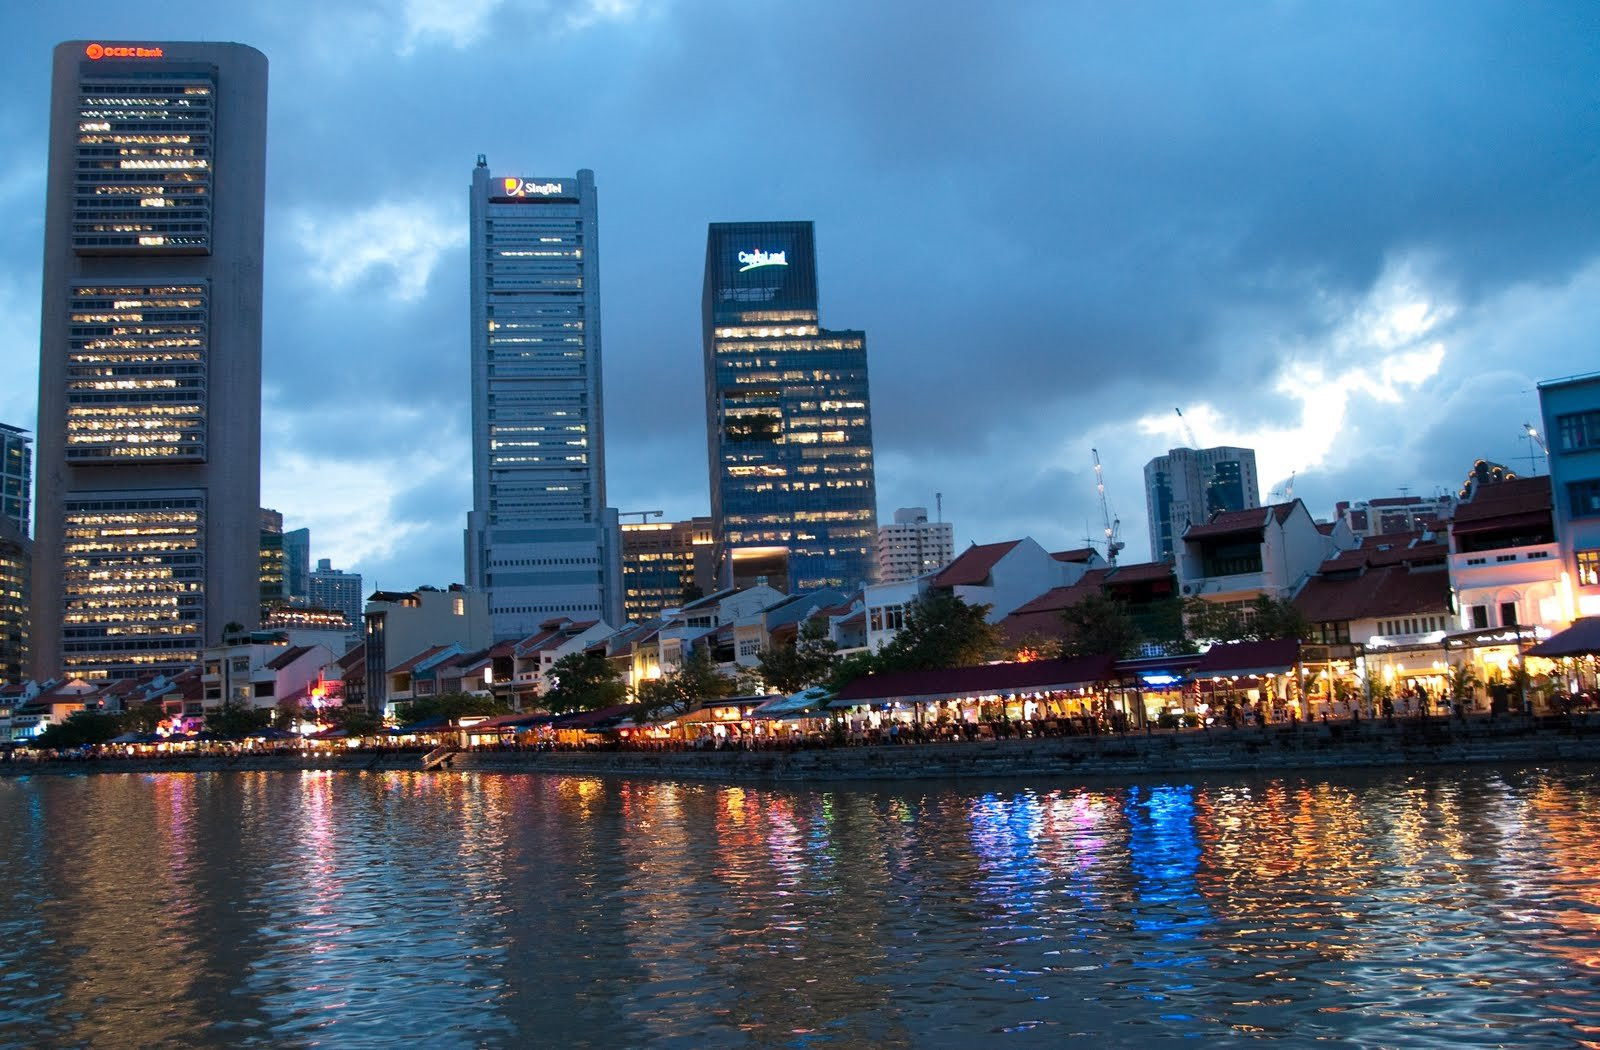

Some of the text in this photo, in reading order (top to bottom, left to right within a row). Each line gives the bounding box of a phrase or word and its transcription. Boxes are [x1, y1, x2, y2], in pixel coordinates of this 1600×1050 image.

[104, 47, 163, 57] OCBC Bank
[525, 183, 562, 195] SingTel
